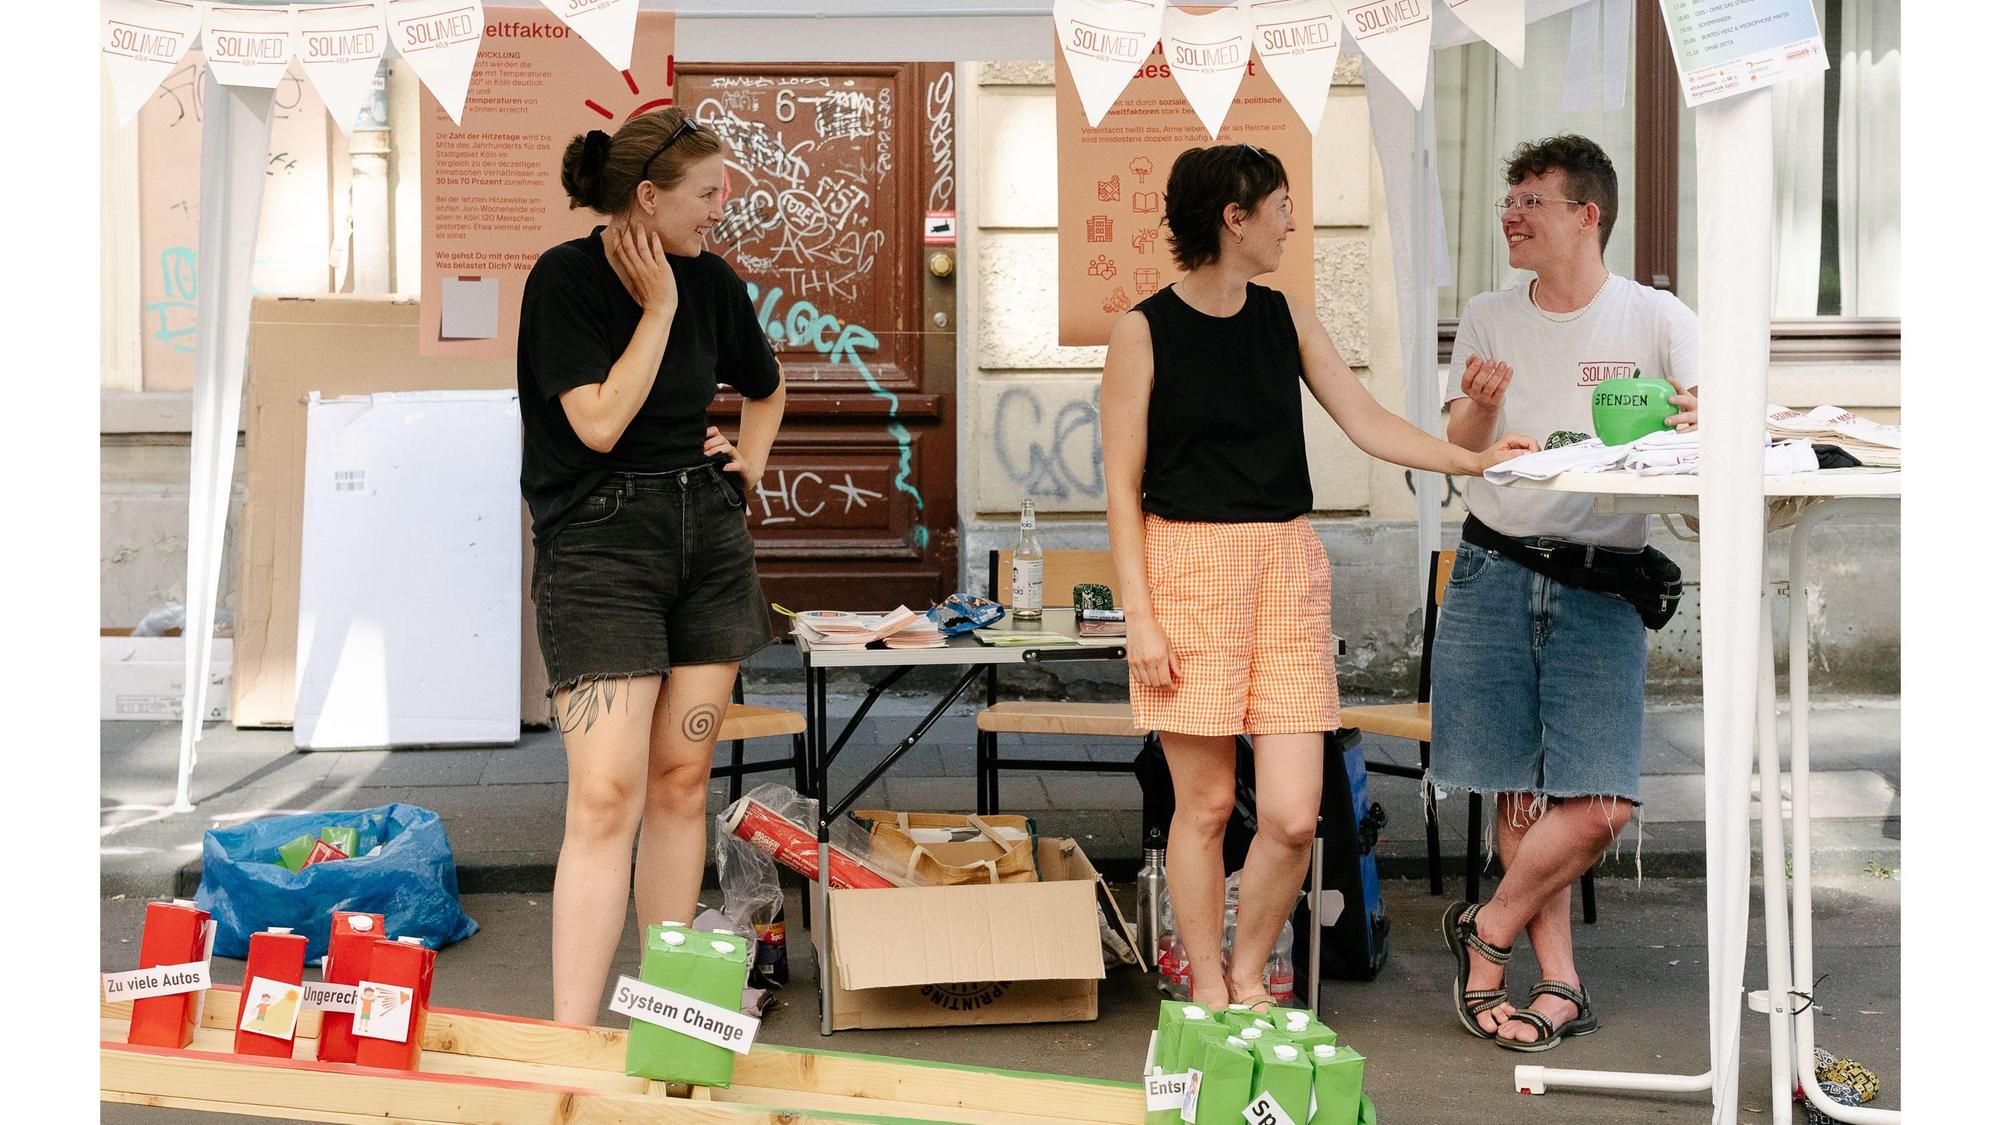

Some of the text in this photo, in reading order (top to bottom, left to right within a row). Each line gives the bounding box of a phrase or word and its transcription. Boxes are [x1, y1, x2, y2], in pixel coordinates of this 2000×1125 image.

[1355, 0, 1422, 33] SOLIMED
[405, 13, 473, 53] SOLIMED
[484, 22, 572, 39] eltfaktor
[1263, 23, 1330, 50] SOLIMED
[110, 28, 176, 58] SOLIMED
[216, 36, 284, 59] SOLIMED
[309, 32, 375, 58] SOLIMED
[1072, 28, 1139, 58] SOLIMED
[477, 51, 521, 59] WICKLUNG
[1175, 44, 1240, 67] SOLIMED
[500, 71, 552, 79] Temperaturen
[466, 97, 523, 106] temperaturen
[776, 88, 796, 123] 6
[1244, 96, 1282, 105] politische
[1107, 107, 1160, 116] weltfaktoren
[1081, 126, 1129, 134] Vereinfacht
[1151, 126, 1162, 134] das,
[436, 132, 447, 140] Die
[449, 132, 466, 140] Zahl
[481, 133, 521, 142] Hitzetage
[1143, 135, 1173, 144] doppelt
[1184, 134, 1209, 143] häufig
[436, 141, 456, 149] Mitte
[472, 142, 522, 150] Jahrhunderts
[524, 142, 535, 150] für
[436, 150, 478, 159] Stadtgebiet
[436, 160, 470, 169] Vergleich
[497, 161, 541, 170] derzeitigen
[483, 169, 535, 177] Verhältnissen
[471, 178, 503, 186] Prozent
[489, 196, 528, 204] Hitzewelle
[496, 214, 535, 222] Menschen
[436, 251, 450, 259] Wie
[451, 252, 474, 261] gehst
[475, 252, 487, 260] Du
[488, 252, 502, 260] mit
[504, 252, 520, 260] den
[453, 262, 487, 270] belastet
[1582, 366, 1631, 383] SOLIMED
[1594, 393, 1649, 407] SPENDEN
[107, 970, 201, 993] Zu viele Autos
[303, 988, 358, 1005] Ungerech
[617, 986, 744, 1041] System Change
